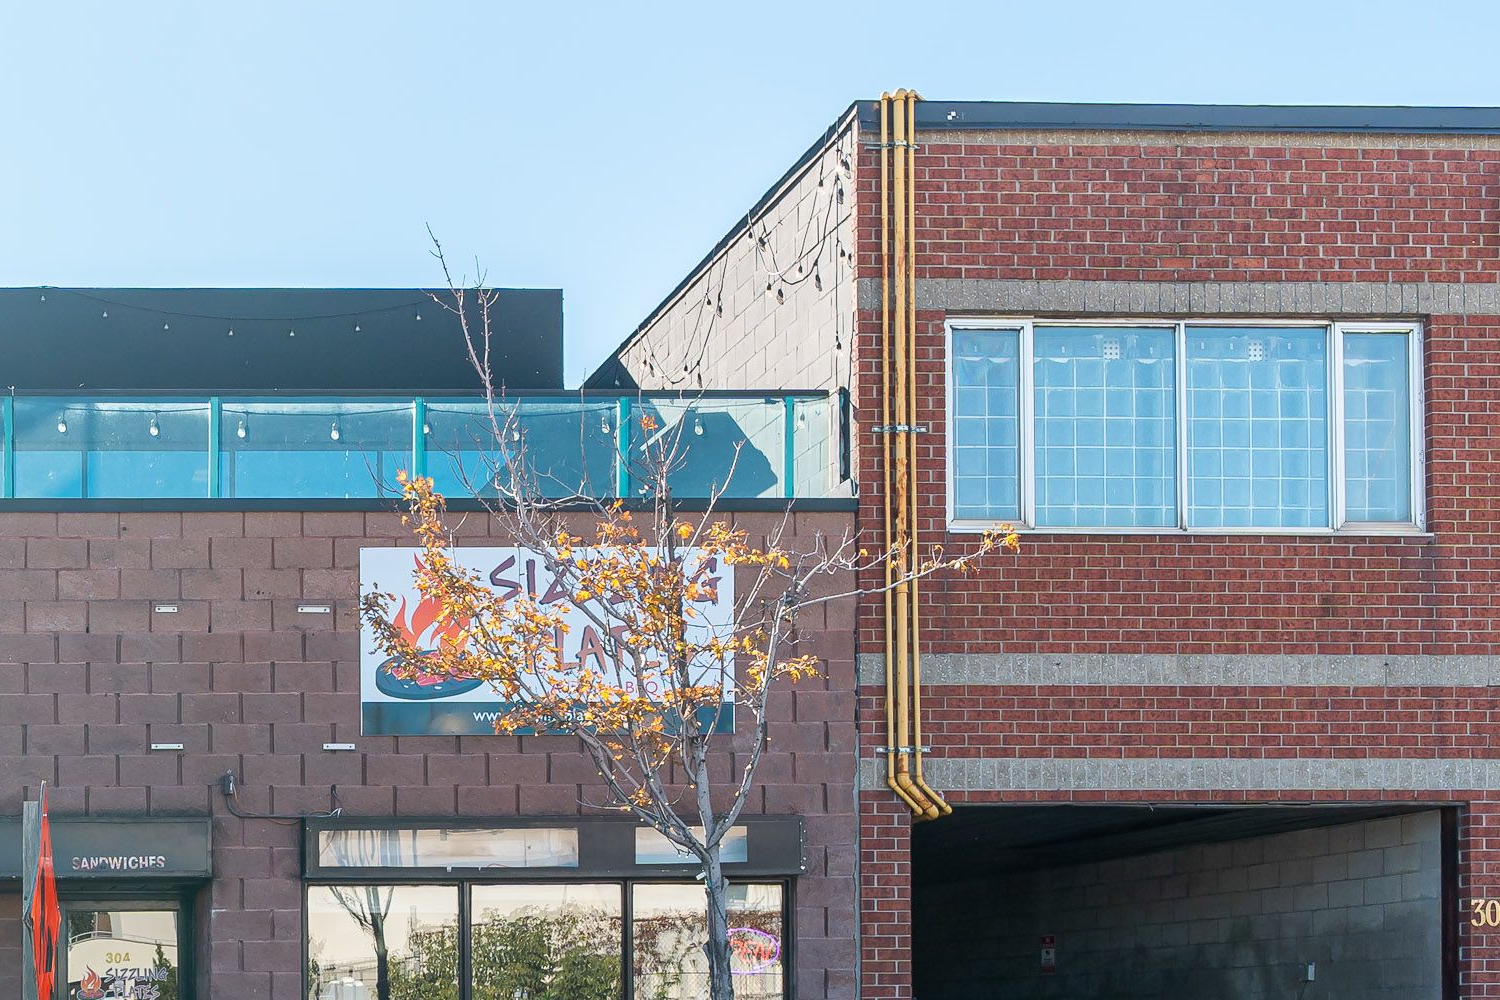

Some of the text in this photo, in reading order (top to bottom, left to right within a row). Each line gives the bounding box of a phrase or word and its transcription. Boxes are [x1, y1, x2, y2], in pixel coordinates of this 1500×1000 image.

[489, 554, 724, 606] SIZG
[625, 681, 659, 695] BQ
[729, 935, 773, 964] PEN
[105, 952, 130, 964] 304
[104, 967, 169, 983] SIZZLING
[114, 984, 161, 1000] PLATES
